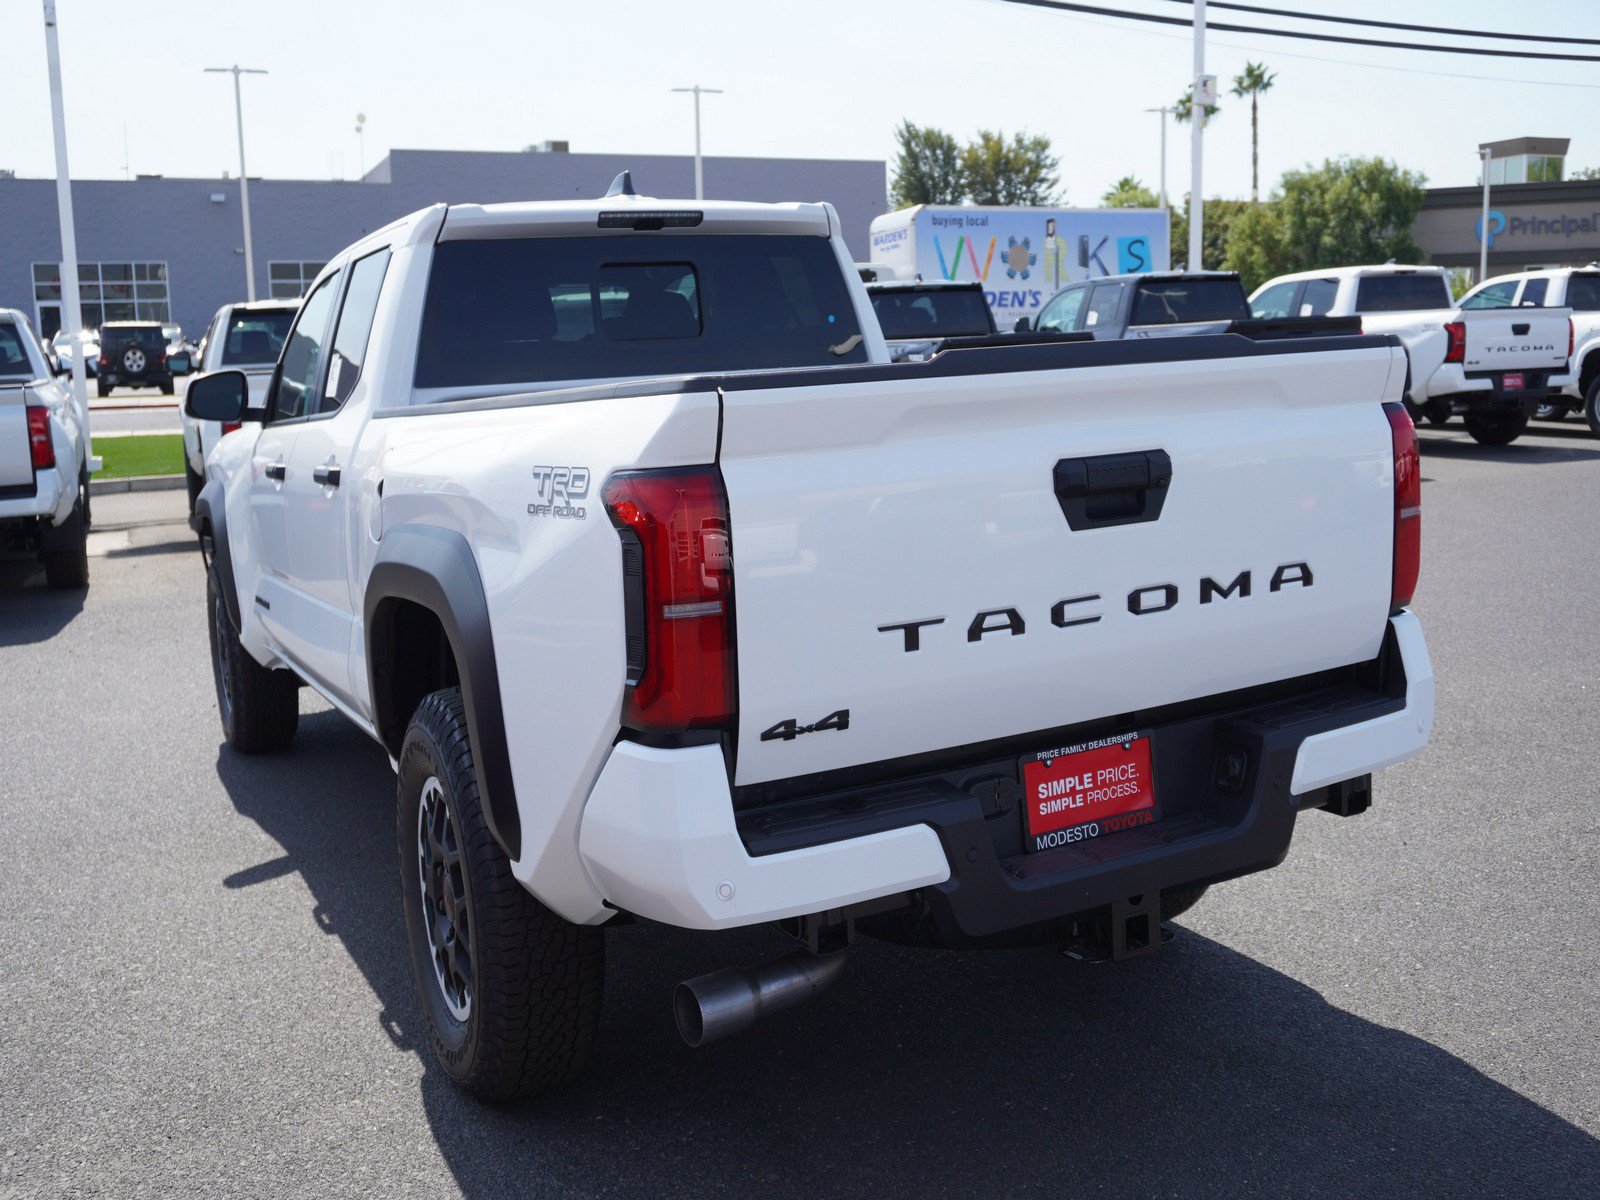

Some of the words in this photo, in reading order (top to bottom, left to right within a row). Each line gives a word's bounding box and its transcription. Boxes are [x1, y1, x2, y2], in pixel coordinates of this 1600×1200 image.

[932, 215, 963, 228] buying
[966, 215, 989, 226] local
[1509, 212, 1598, 238] Principal
[983, 289, 1041, 307] DEN'S
[1485, 345, 1554, 353] TACOMA
[532, 465, 591, 507] TRD
[527, 503, 552, 517] OFF
[553, 505, 587, 520] ROAD
[877, 560, 1314, 653] TACOMA
[1037, 748, 1060, 761] PRICE
[1060, 743, 1087, 756] FAMILY
[1088, 731, 1139, 750] DEALERSHIPS
[1038, 772, 1094, 799] SIMPLE
[1097, 763, 1140, 786] PRICE.
[1039, 794, 1084, 816] SIMPLE
[1087, 782, 1141, 804] PROCESS.
[1036, 823, 1099, 851] MODESTO
[1102, 812, 1153, 833] TOYOTA
